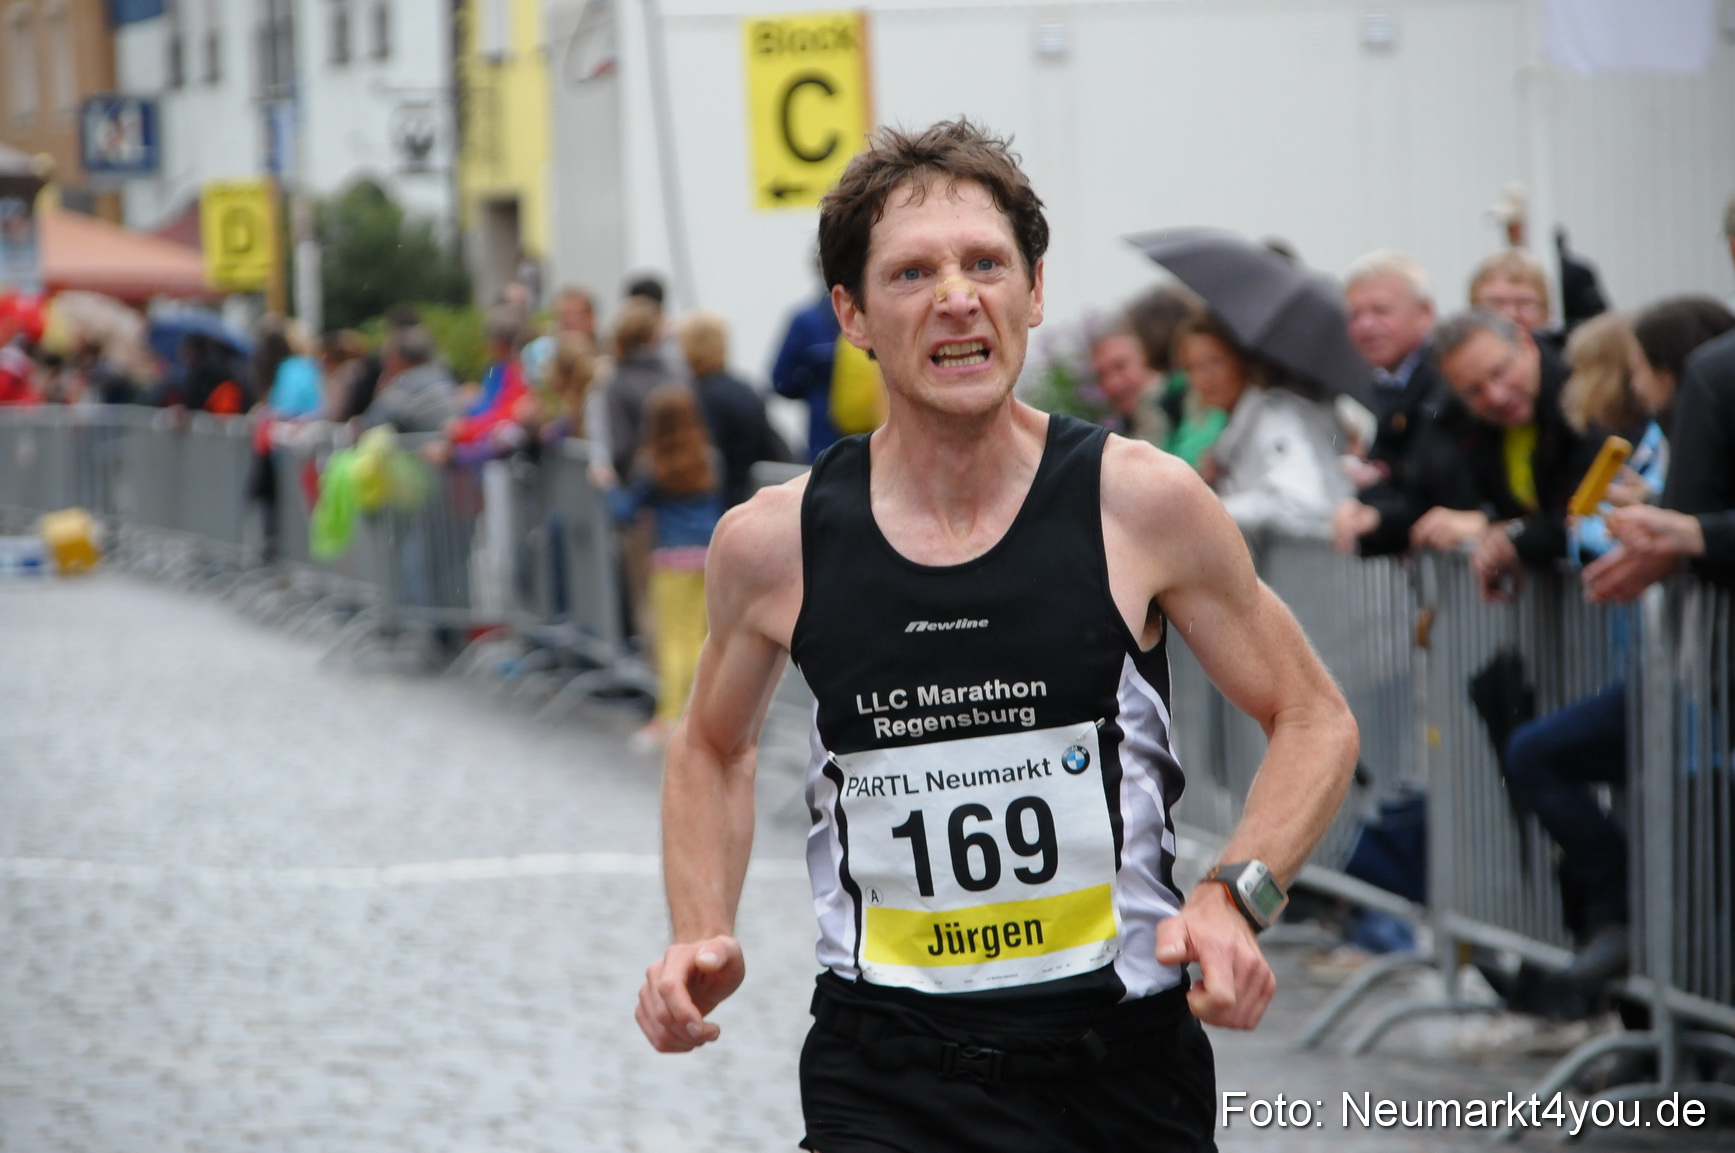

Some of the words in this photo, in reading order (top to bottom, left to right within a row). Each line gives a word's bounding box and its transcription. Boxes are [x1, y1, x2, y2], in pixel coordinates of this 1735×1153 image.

[774, 68, 840, 169] C
[856, 689, 908, 715] LLC
[917, 679, 1047, 707] Marathon
[873, 706, 1036, 739] Regensburg
[846, 775, 920, 797] PARTL
[926, 757, 1053, 793] Neumarkt
[891, 795, 1058, 897] 169
[927, 918, 1044, 958] Jürgen
